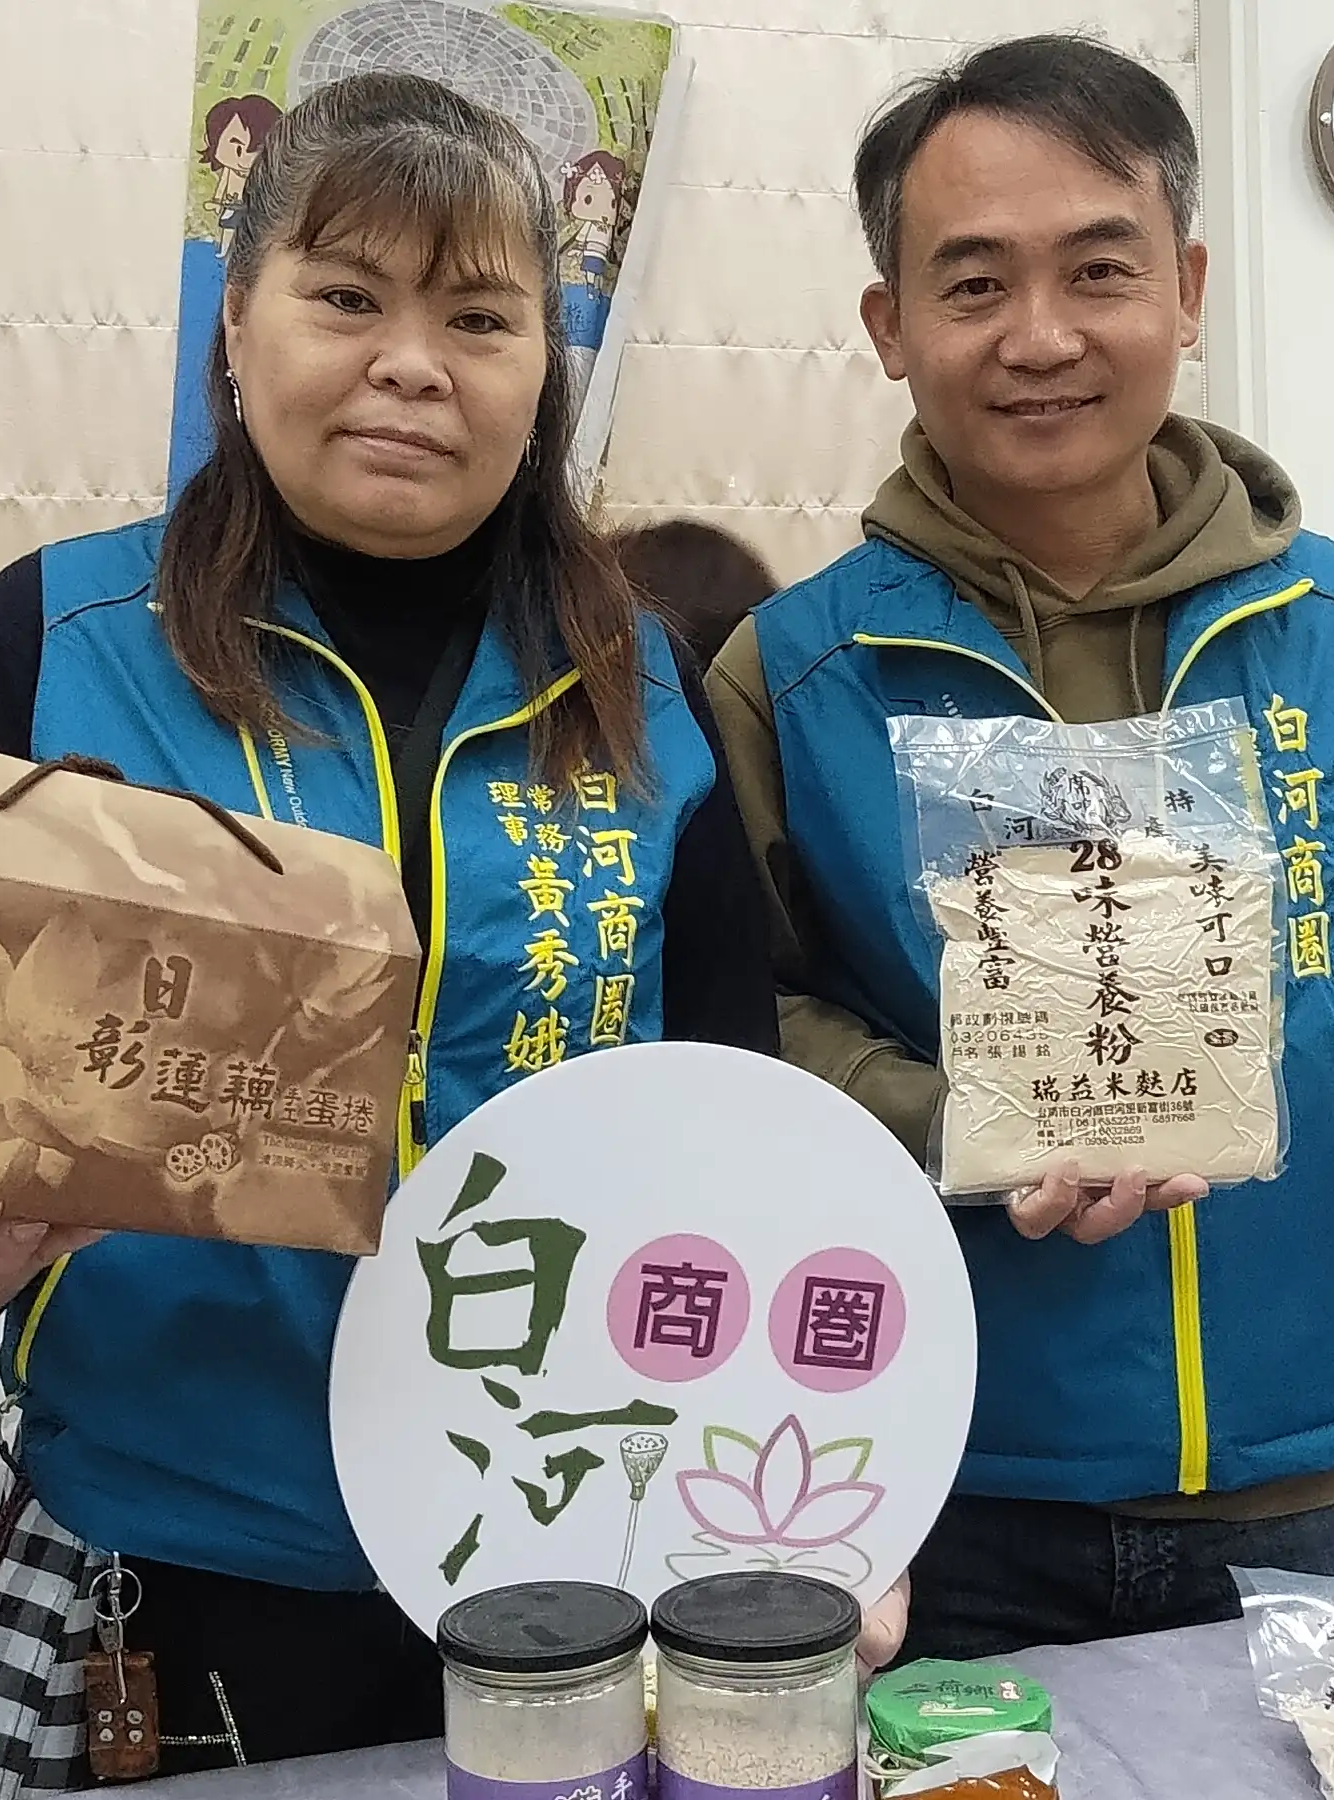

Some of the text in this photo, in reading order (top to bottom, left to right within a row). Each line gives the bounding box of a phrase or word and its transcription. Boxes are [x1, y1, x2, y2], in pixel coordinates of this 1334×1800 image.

[486, 781, 529, 846] 理事
[525, 783, 572, 854] 常務
[1262, 692, 1332, 979] 白河商圈
[572, 772, 646, 1047] 白河商圈
[1189, 842, 1236, 977] 美味可口
[416, 1151, 680, 1587] 白河
[633, 1262, 885, 1372] 商圈
